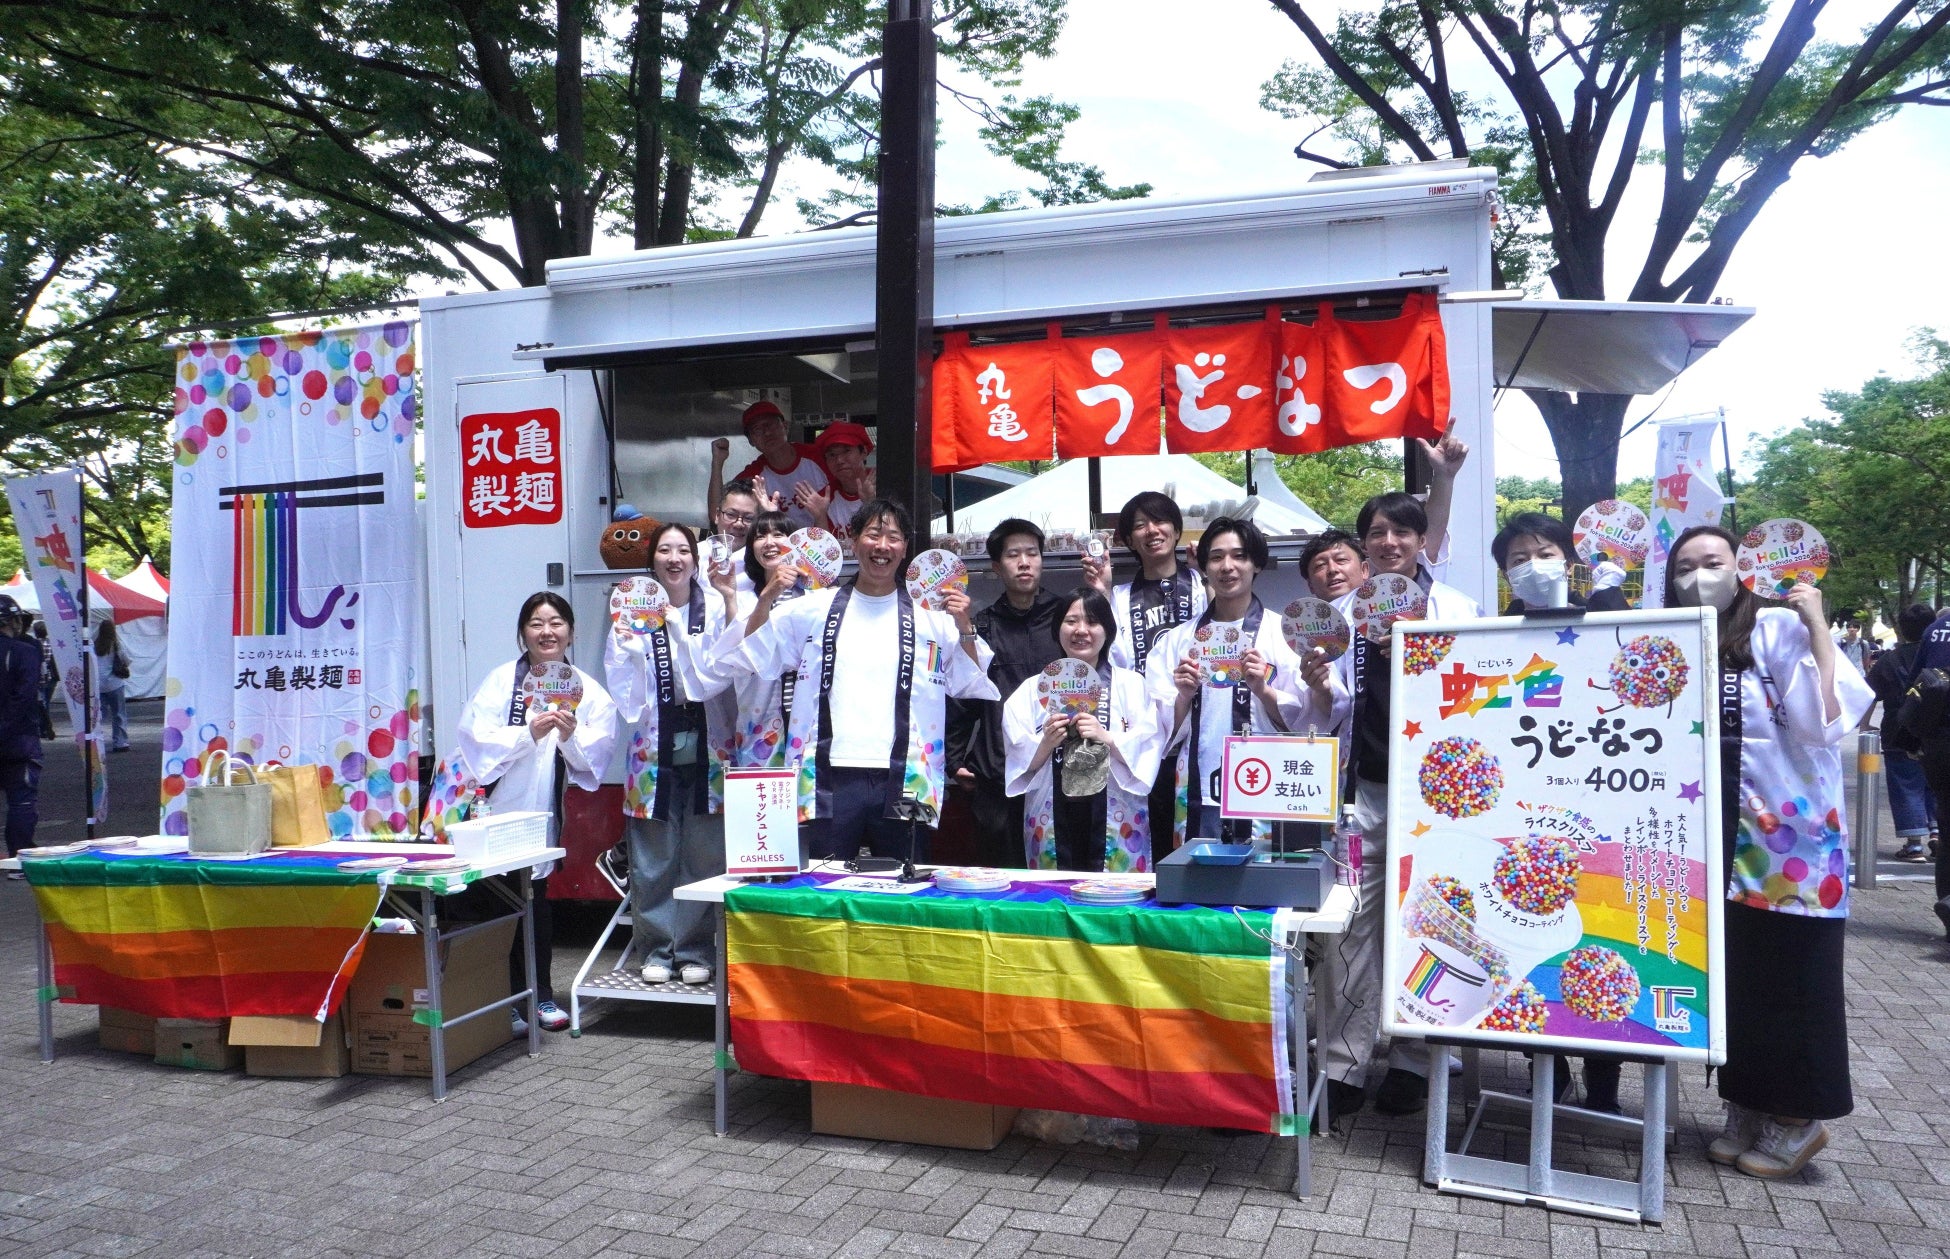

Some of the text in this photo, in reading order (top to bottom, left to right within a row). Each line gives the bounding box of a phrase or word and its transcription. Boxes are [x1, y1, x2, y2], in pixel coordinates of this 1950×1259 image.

[1428, 185, 1451, 196] FIAMMA
[975, 362, 1029, 442] 丸亀
[467, 419, 555, 466] 丸亀
[468, 471, 556, 518] 製麺
[1590, 528, 1605, 538] Tokyo
[1595, 519, 1636, 543] Hello!
[1755, 563, 1774, 571] Tokyo
[1775, 558, 1793, 566] Pride
[1756, 542, 1805, 564] Hello!
[919, 563, 949, 589] Hello!
[624, 596, 656, 606] Hello!
[1368, 595, 1408, 613] Hello!
[1131, 604, 1146, 665] TORIDOLL
[1295, 620, 1332, 632] Hello!
[1930, 629, 1950, 643] ST
[237, 647, 360, 660] ここのうどんは、生きている。
[822, 612, 840, 680] TORIDOLL
[900, 613, 912, 680] TORIDOLL
[1202, 644, 1237, 655] Hello!
[655, 630, 671, 694] TORIDOLL
[1478, 658, 1514, 668] にじいろ
[234, 664, 344, 692] 丸亀製麺
[537, 681, 570, 689] Hello!
[1052, 680, 1087, 689] Hello!
[1439, 652, 1565, 721] 虹色
[1511, 715, 1663, 769] うどーなつ
[1283, 760, 1315, 776] 現金
[1546, 775, 1580, 786] 3個入り
[1584, 766, 1666, 792] 400円
[1274, 782, 1322, 798] 支払い
[756, 782, 768, 851] キャッシュレス
[1287, 803, 1308, 812] Cash
[1537, 804, 1596, 834] ザクザク食感の
[1525, 816, 1597, 854] ライスクリスプ
[740, 854, 785, 862] CASHLESS
[1647, 806, 1661, 899] 多様性をイメージした
